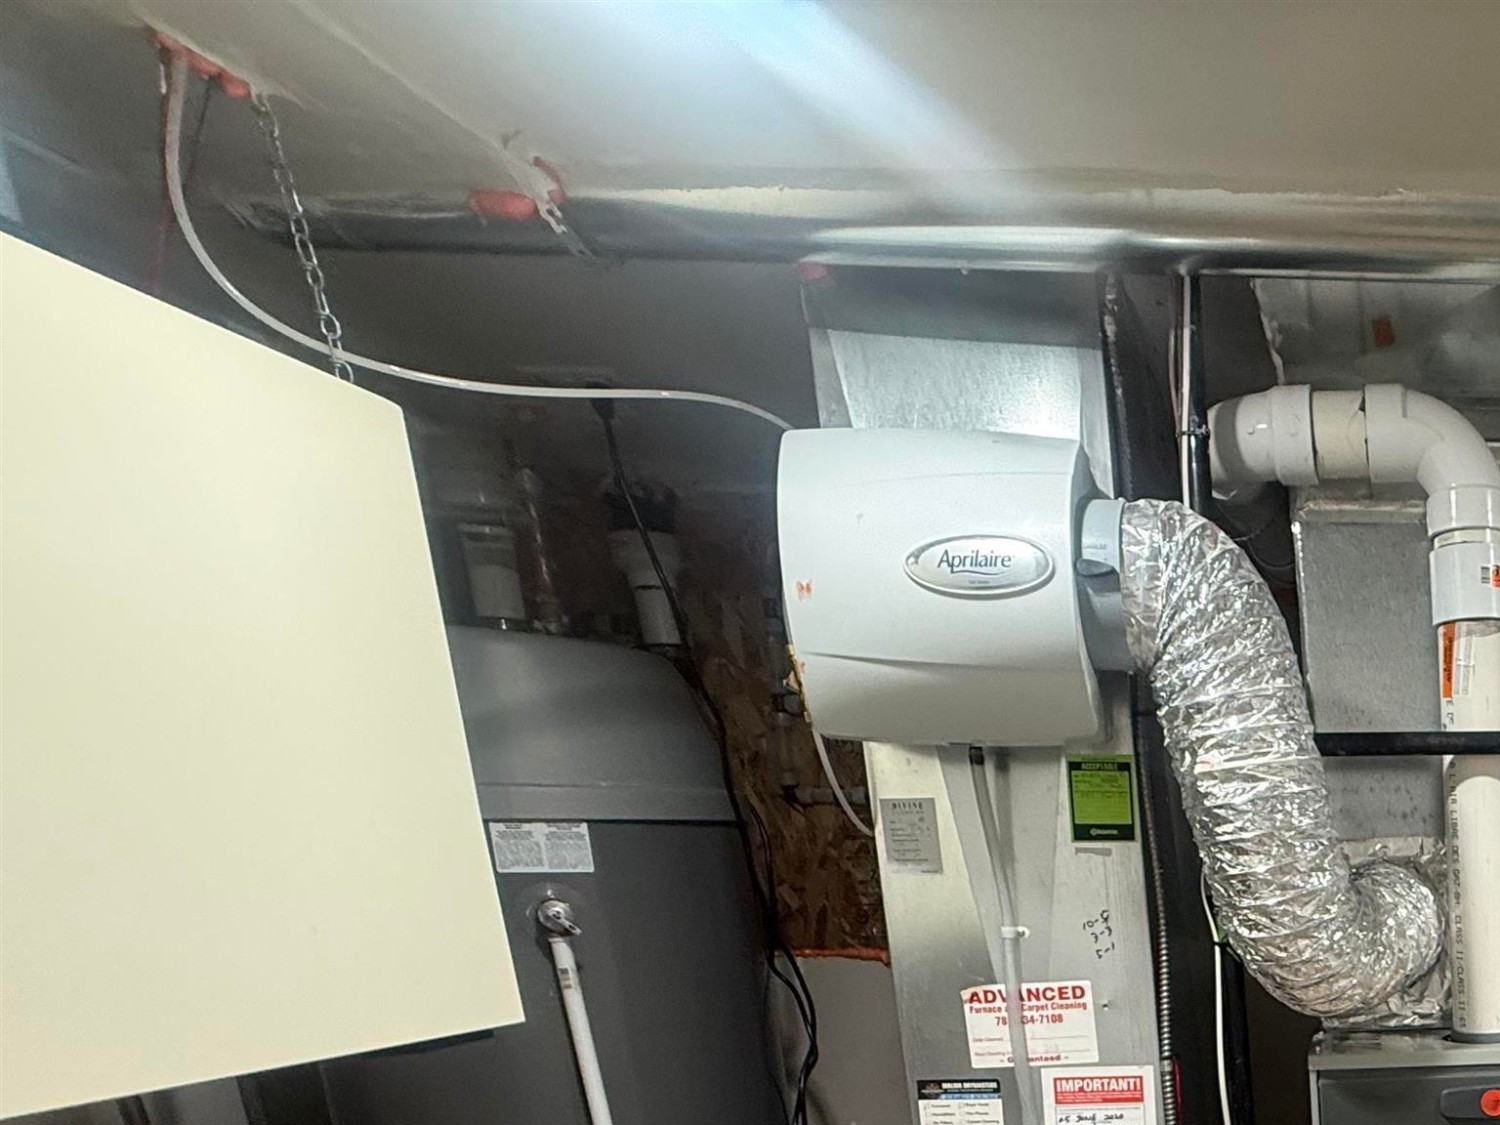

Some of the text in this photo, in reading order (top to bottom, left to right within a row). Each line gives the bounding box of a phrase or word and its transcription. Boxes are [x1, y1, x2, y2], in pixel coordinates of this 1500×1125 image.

[937, 549, 1012, 574] Aprilaire
[1454, 915, 1463, 944] CLASS
[969, 985, 1086, 1004] ADVNCED
[969, 1001, 1088, 1014] Furnace Carpet Cleaning
[995, 1014, 1064, 1026] 7834-7108
[1056, 1078, 1141, 1092] IMPORTANT!
